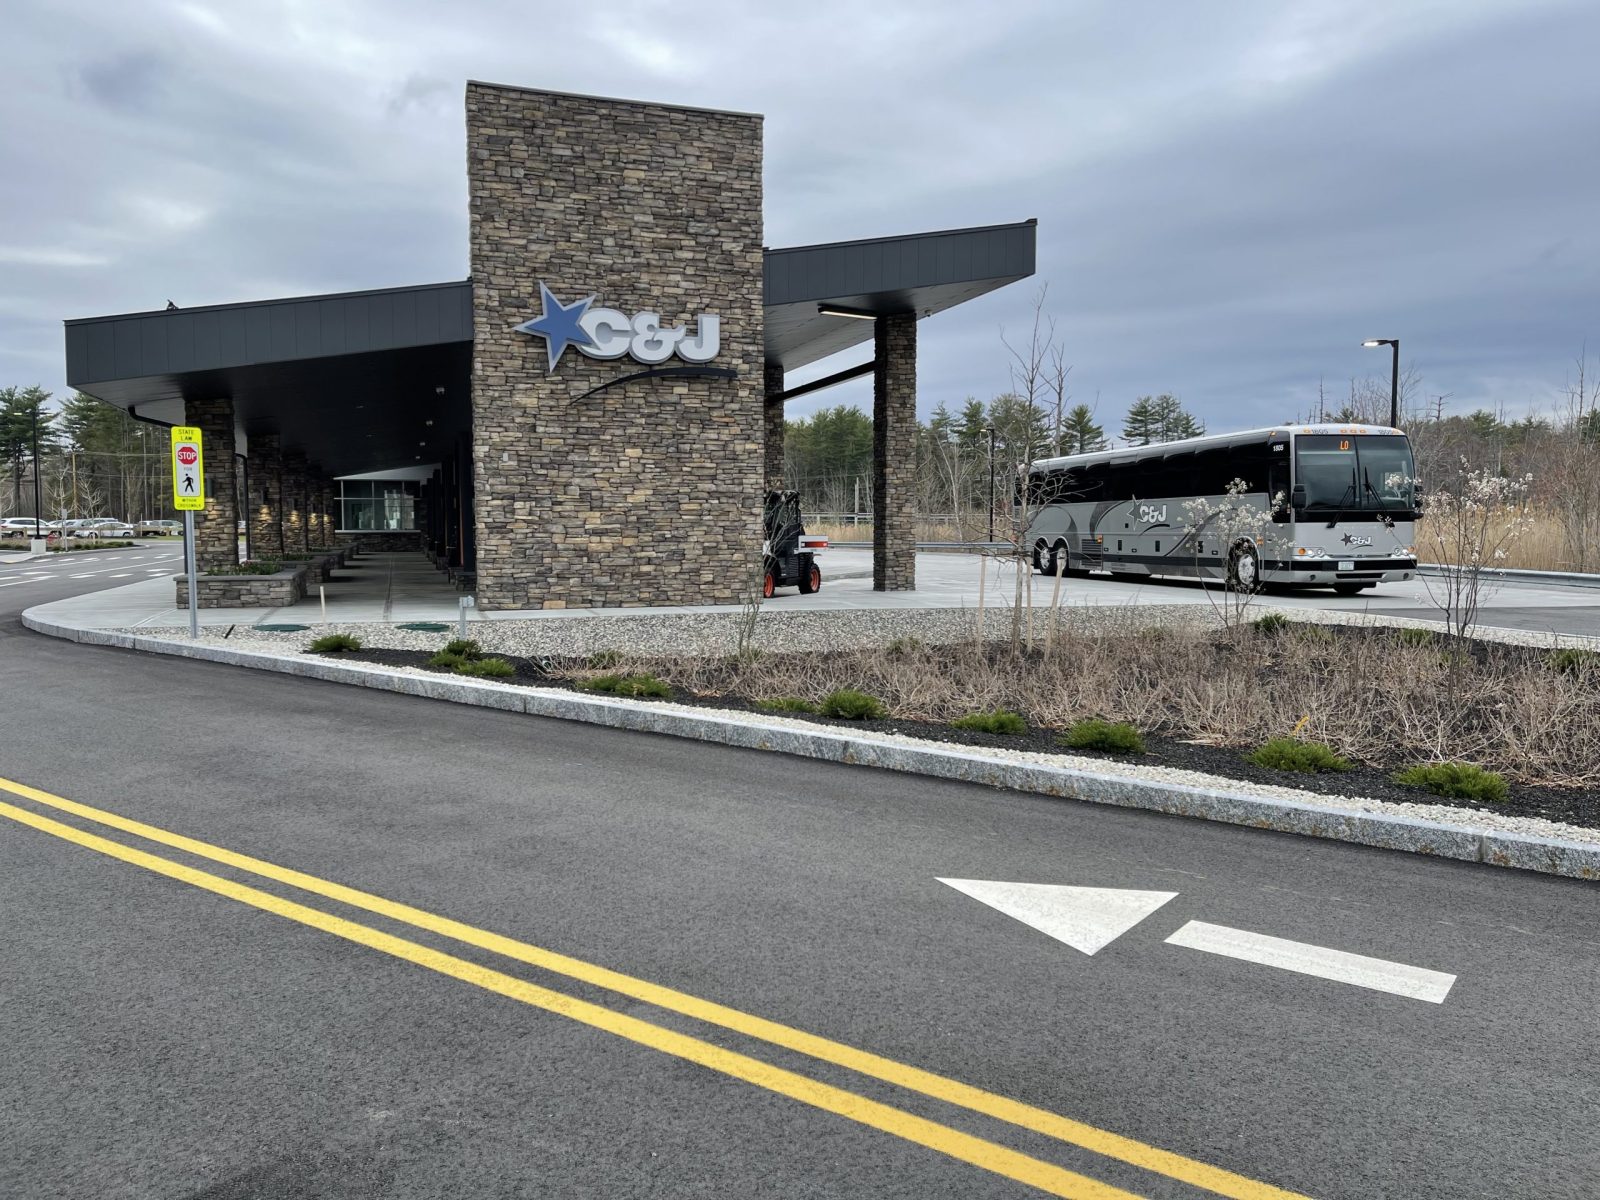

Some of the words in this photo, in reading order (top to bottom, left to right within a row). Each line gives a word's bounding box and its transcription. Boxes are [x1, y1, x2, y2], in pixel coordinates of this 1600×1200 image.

[575, 307, 720, 364] C&J
[178, 452, 197, 460] STOP
[1140, 504, 1168, 523] C&J
[1349, 536, 1372, 545] C&J
